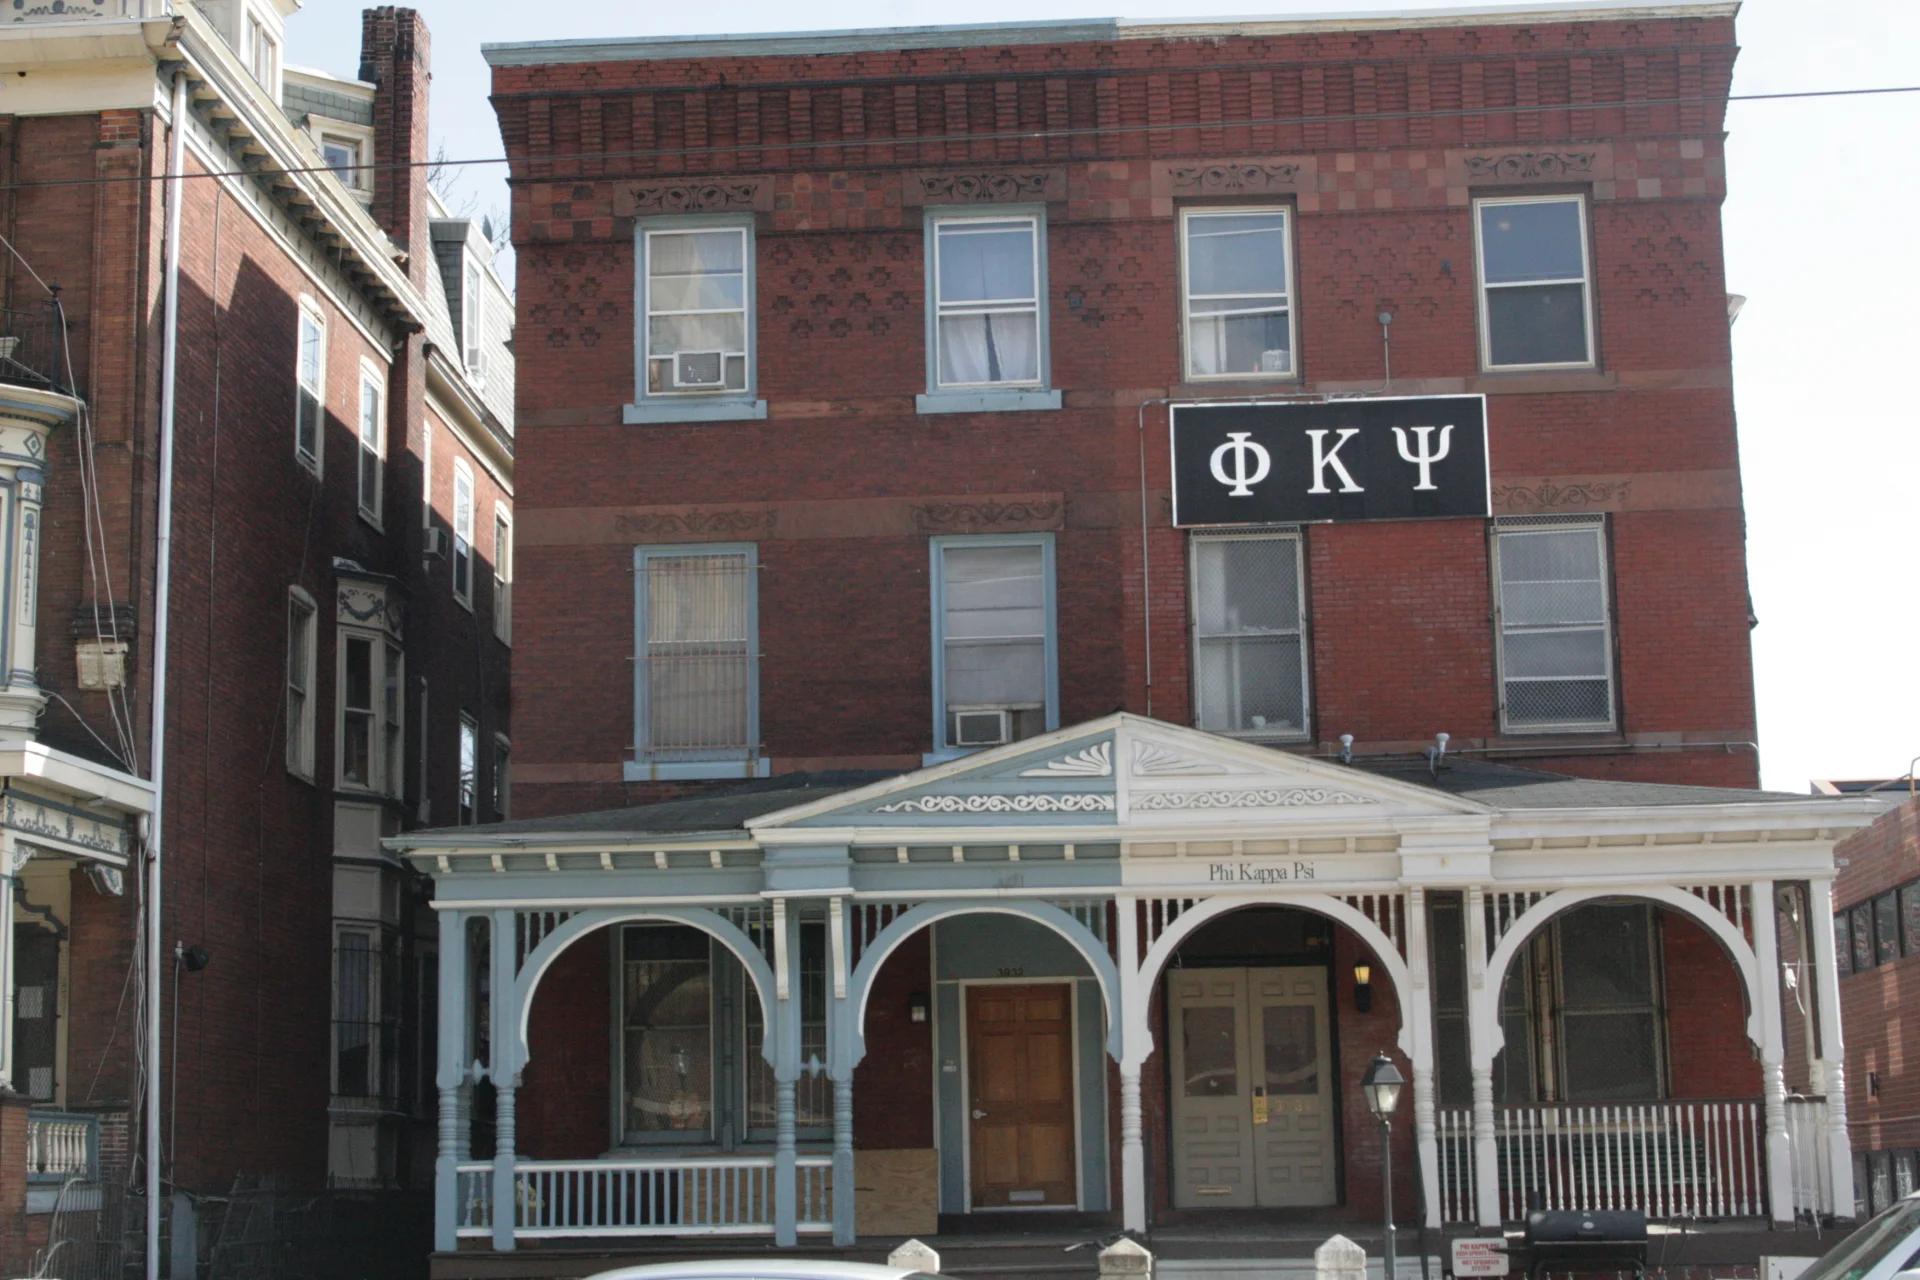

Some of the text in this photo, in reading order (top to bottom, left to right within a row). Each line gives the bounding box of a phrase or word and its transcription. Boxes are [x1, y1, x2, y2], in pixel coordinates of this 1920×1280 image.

[1210, 432, 1271, 496] Φ
[1391, 424, 1455, 490] Ψ
[1209, 861, 1315, 884] Phi Kappa Psi
